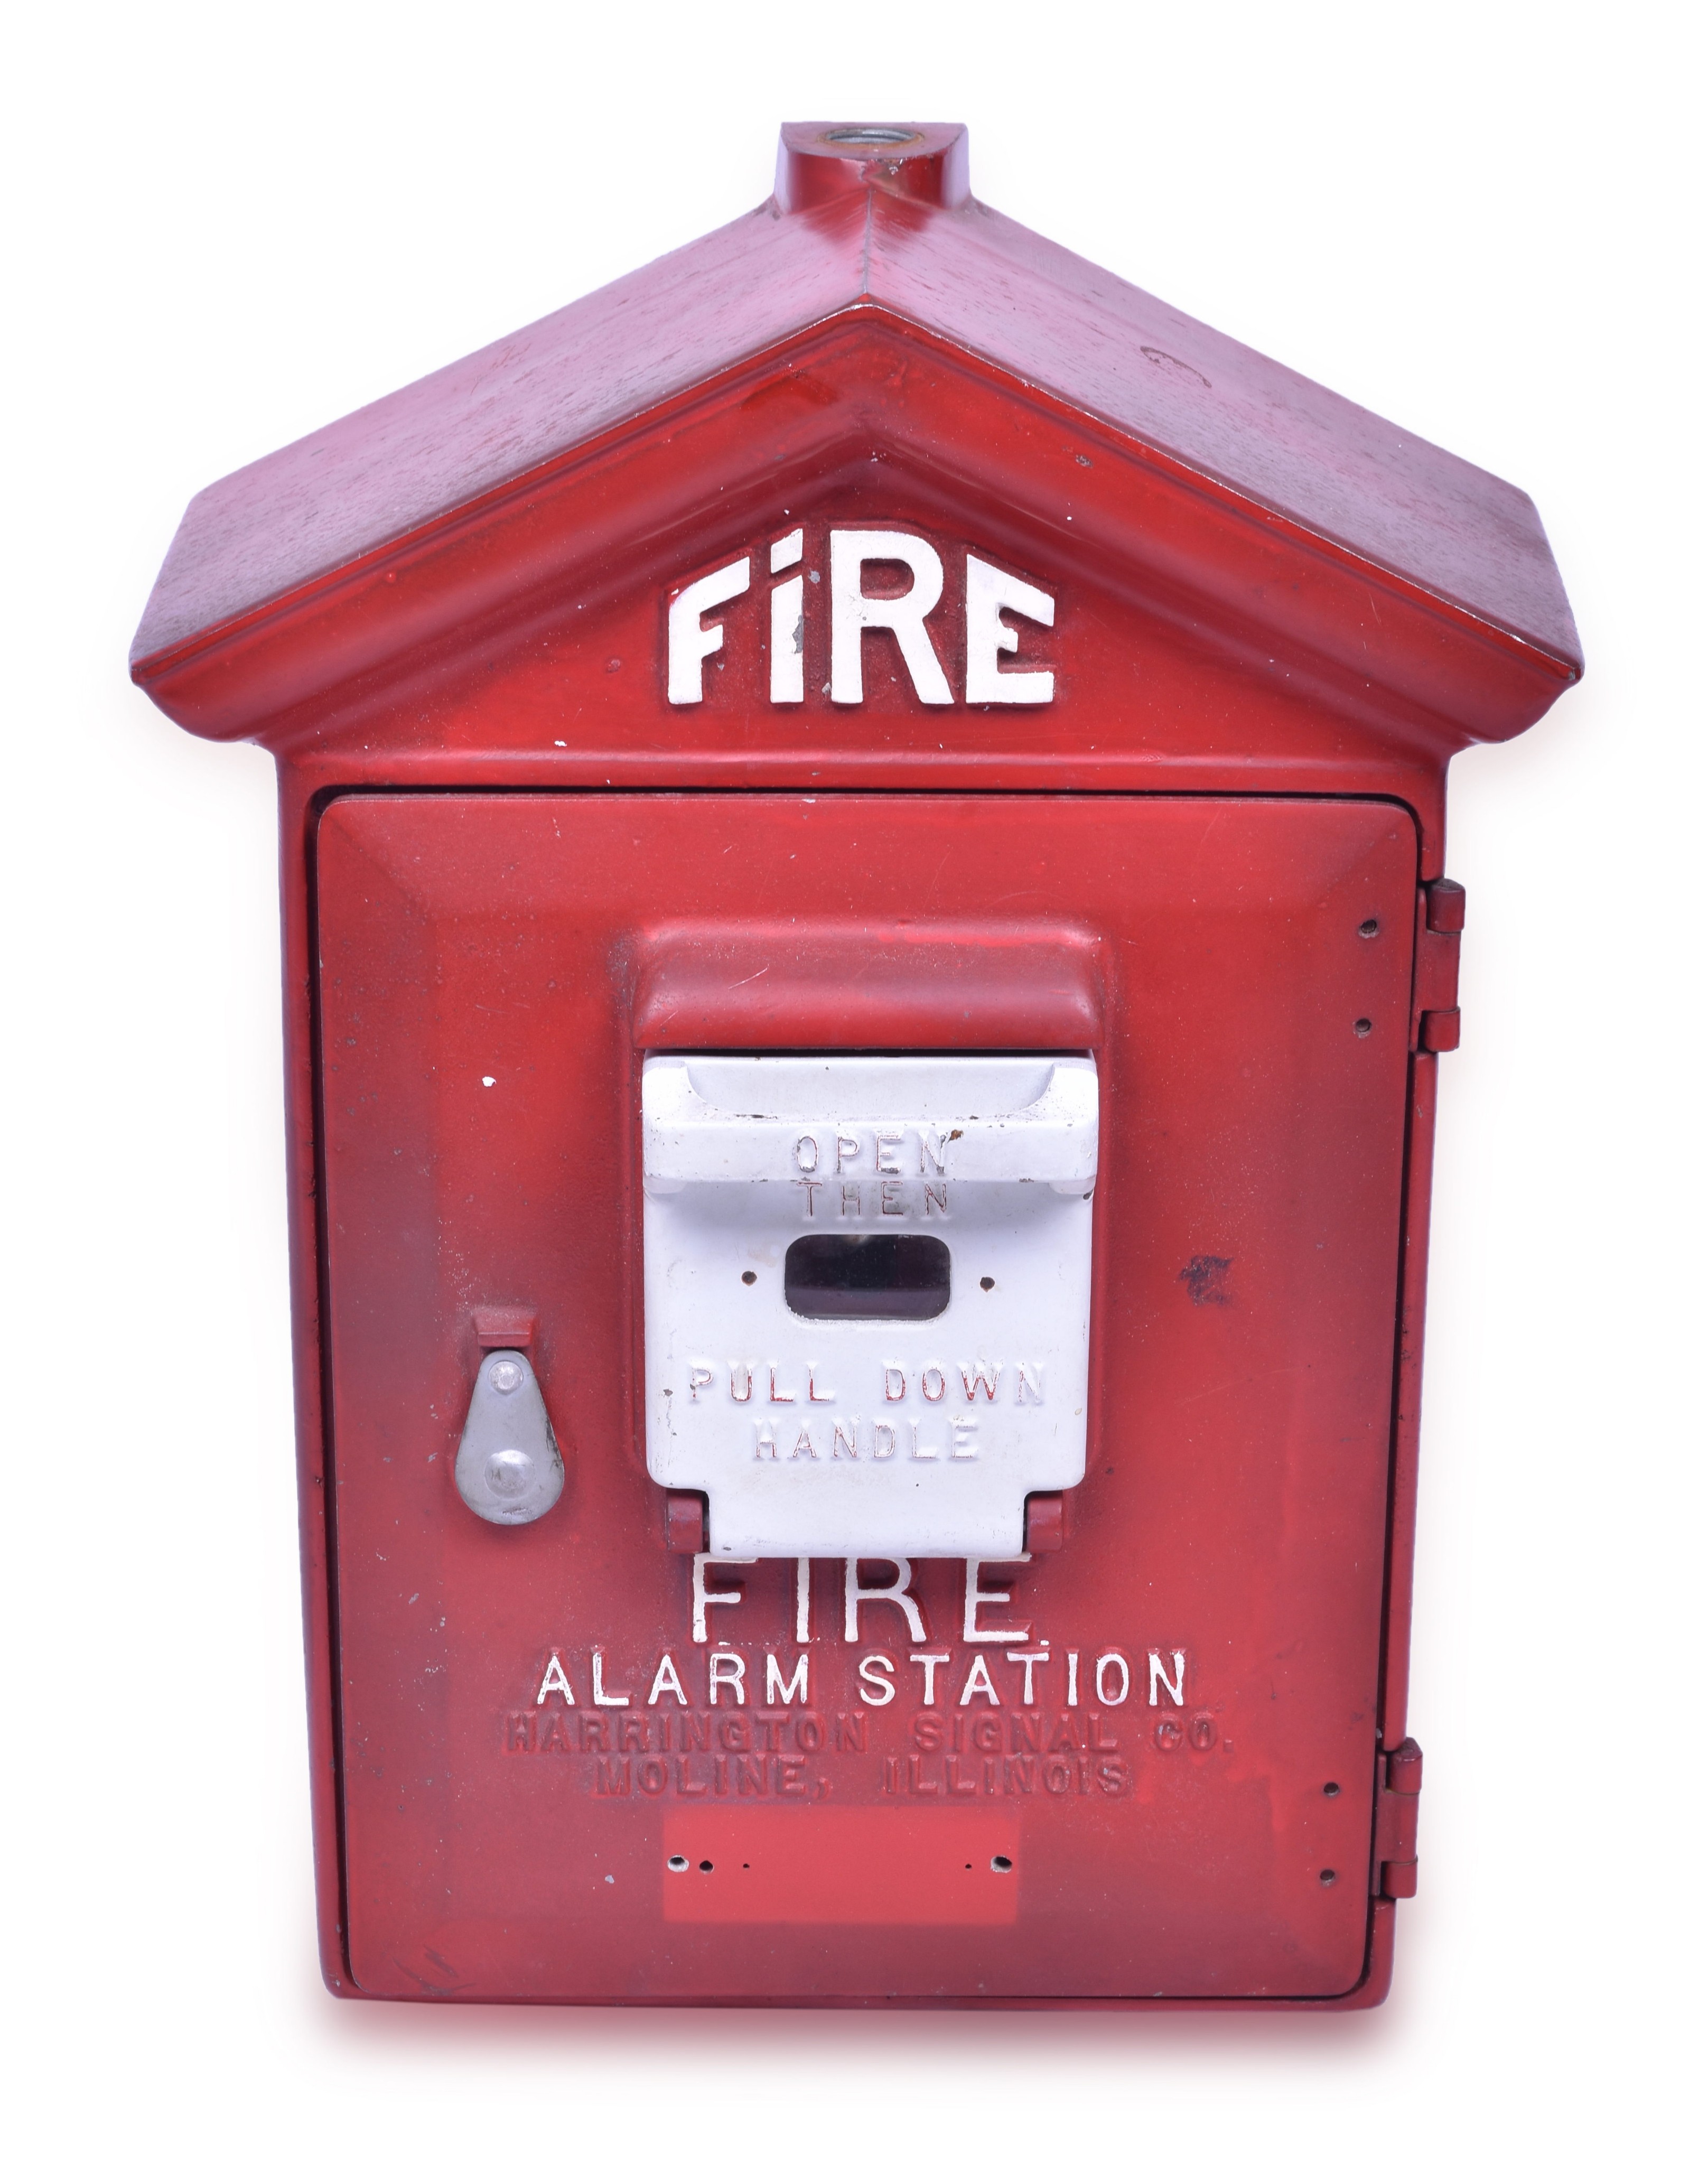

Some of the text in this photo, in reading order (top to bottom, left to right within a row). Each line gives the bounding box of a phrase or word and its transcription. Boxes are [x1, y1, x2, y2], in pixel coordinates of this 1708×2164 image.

[795, 1130, 947, 1174] OPEN
[797, 1180, 949, 1218] THEN
[688, 1361, 1046, 1403] PULL DOWN
[752, 1416, 979, 1461] HANDLE
[692, 1553, 1032, 1643] FIRE
[537, 1652, 1186, 1706] ALARM STATION
[505, 1711, 1234, 1752] HARRINGTON SIGNAL CO.
[595, 1754, 1130, 1797] MOLINE, ILLINOIS
